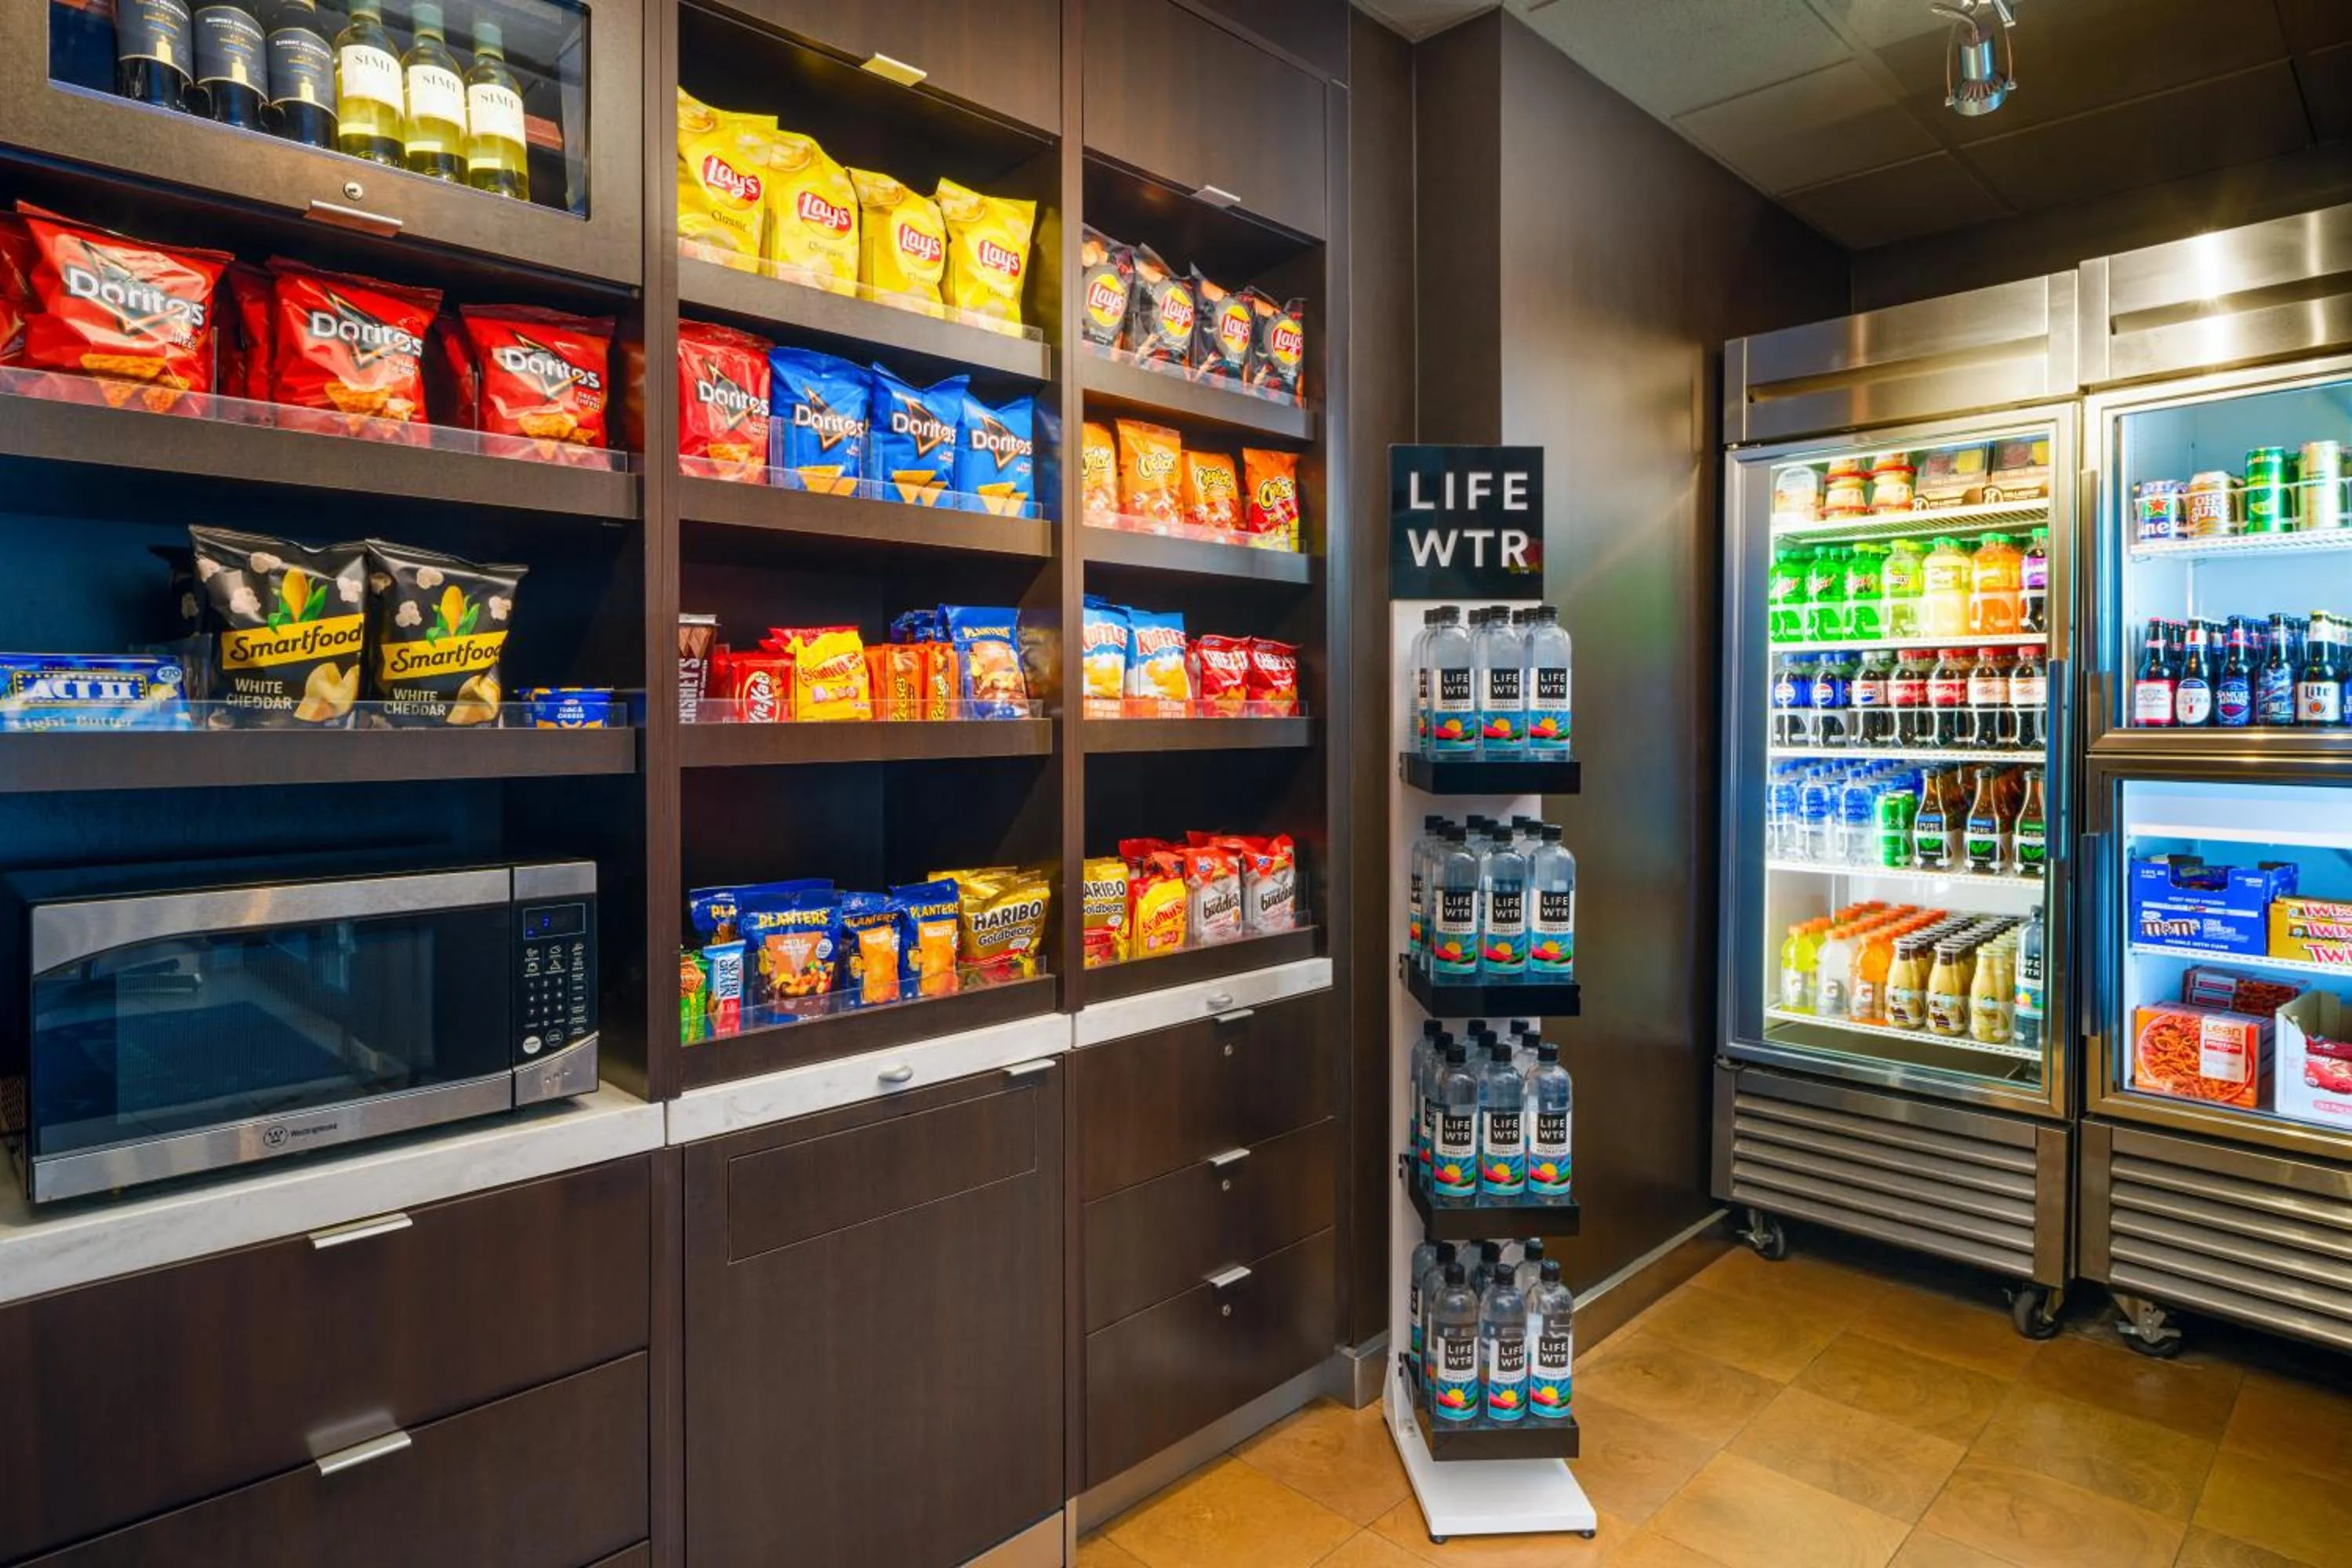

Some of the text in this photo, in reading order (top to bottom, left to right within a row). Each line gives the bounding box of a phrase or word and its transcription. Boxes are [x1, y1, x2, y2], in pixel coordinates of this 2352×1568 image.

[355, 54, 390, 74] SIMI
[423, 74, 456, 94] SIMI
[481, 93, 514, 111] SIMI
[706, 156, 760, 198] Lay's
[800, 193, 850, 232] Lay's
[902, 225, 941, 263] Lay's
[982, 242, 1019, 275] Lay's
[69, 266, 205, 327] Doritos
[1094, 283, 1124, 314] Lay's
[1166, 297, 1192, 326] Lay's
[311, 311, 423, 358] Doritos
[503, 347, 601, 390] Doritos
[698, 380, 769, 416] Doritos
[795, 405, 864, 437] Doritos
[892, 412, 956, 444] Doritos
[971, 430, 1033, 456] Doritos
[1410, 471, 1528, 510] LIFE
[1406, 528, 1529, 568] WTR
[230, 622, 364, 663] Smartfood
[1444, 673, 1468, 683] LIFE
[1494, 673, 1519, 683] LIFE
[1541, 673, 1566, 683] LIFE
[31, 679, 135, 699] ACT II
[235, 677, 283, 695] WHITE
[1444, 686, 1468, 695] WTR
[1493, 685, 1519, 695] WTR
[1541, 684, 1566, 694] WTR
[226, 691, 293, 711] CHEDDAR
[393, 688, 438, 704] WHITE
[383, 702, 447, 717] CHEDDAR
[1446, 897, 1472, 906] LIFE
[1495, 898, 1520, 907] LIFE
[1543, 896, 1568, 906] LIFE
[758, 907, 831, 929] PLANTERS
[973, 900, 1043, 932] HARIBO
[1446, 909, 1472, 917] WTR
[1495, 909, 1520, 919] WTR
[1543, 907, 1569, 917] WTR
[1446, 1120, 1470, 1130] LIFE
[1494, 1119, 1518, 1129] LIFE
[1540, 1119, 1565, 1128] LIFE
[1446, 1131, 1470, 1142] WTR
[1494, 1131, 1519, 1140] WTR
[1540, 1130, 1566, 1139] WTR
[1448, 1345, 1472, 1355] LIFE
[1501, 1345, 1523, 1356] LIFE
[1542, 1341, 1566, 1352] LIFE
[1448, 1356, 1472, 1366] WTR
[1501, 1357, 1523, 1367] WTR
[1541, 1353, 1566, 1363] WTR
